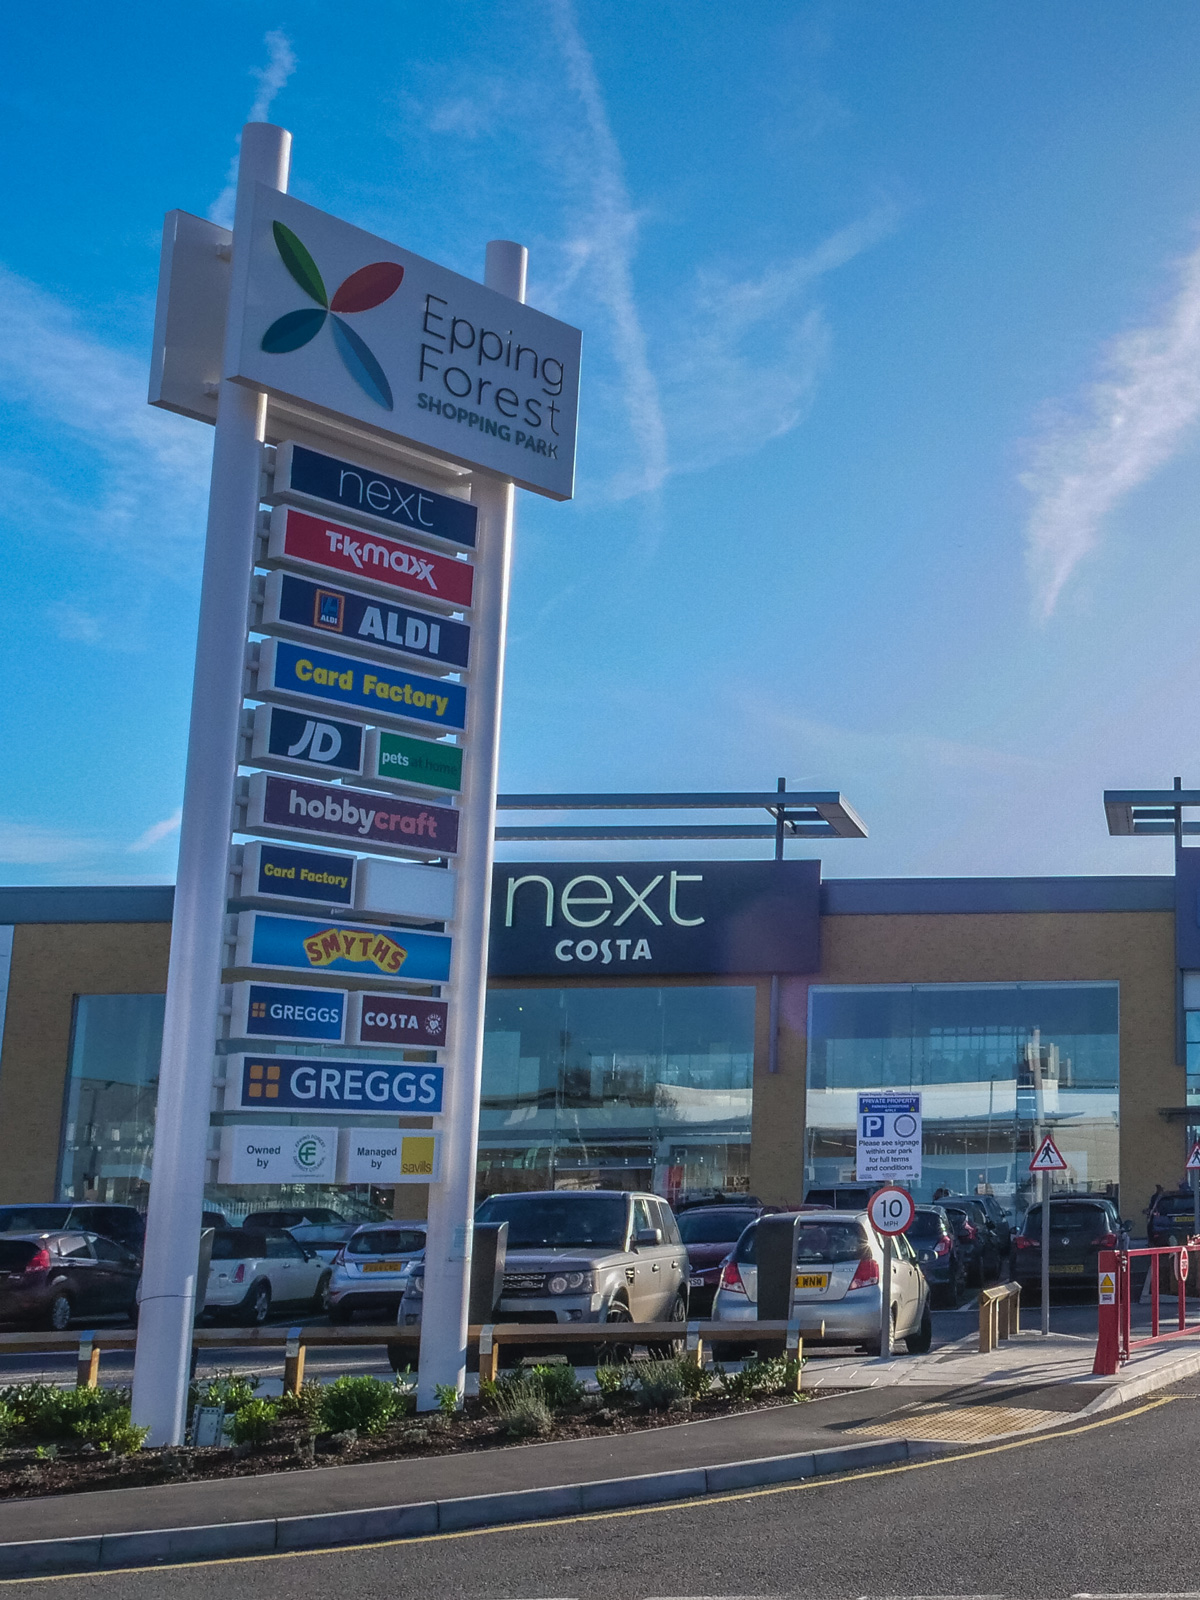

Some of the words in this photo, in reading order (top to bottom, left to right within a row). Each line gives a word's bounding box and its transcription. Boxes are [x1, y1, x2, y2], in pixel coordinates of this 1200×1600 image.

[422, 293, 564, 396] Epping
[419, 343, 560, 437] Forest
[417, 392, 511, 442] SHOPPING
[515, 430, 559, 460] PARK
[339, 469, 434, 527] next
[320, 614, 338, 624] ALDI
[358, 606, 441, 655] ALDI
[295, 659, 353, 690] Card
[363, 674, 449, 716] Factory
[287, 720, 342, 762] JD
[382, 750, 409, 766] pets
[410, 756, 423, 769] at
[425, 757, 458, 776] home
[289, 789, 438, 838] hobbycraft
[264, 863, 296, 879] Card
[300, 869, 348, 888] Factory
[505, 870, 706, 928] next
[305, 933, 406, 971] SMYTHS
[555, 939, 652, 964] COSTA
[270, 1003, 339, 1024] GREGGS
[364, 1011, 419, 1030] COSTA
[290, 1067, 436, 1104] GREGGS
[866, 1117, 882, 1137] P
[246, 1145, 281, 1155] Owned
[357, 1147, 397, 1159] Managed
[256, 1157, 269, 1169] by
[371, 1159, 382, 1170] by
[402, 1161, 432, 1173] savills
[880, 1199, 903, 1218] 10
